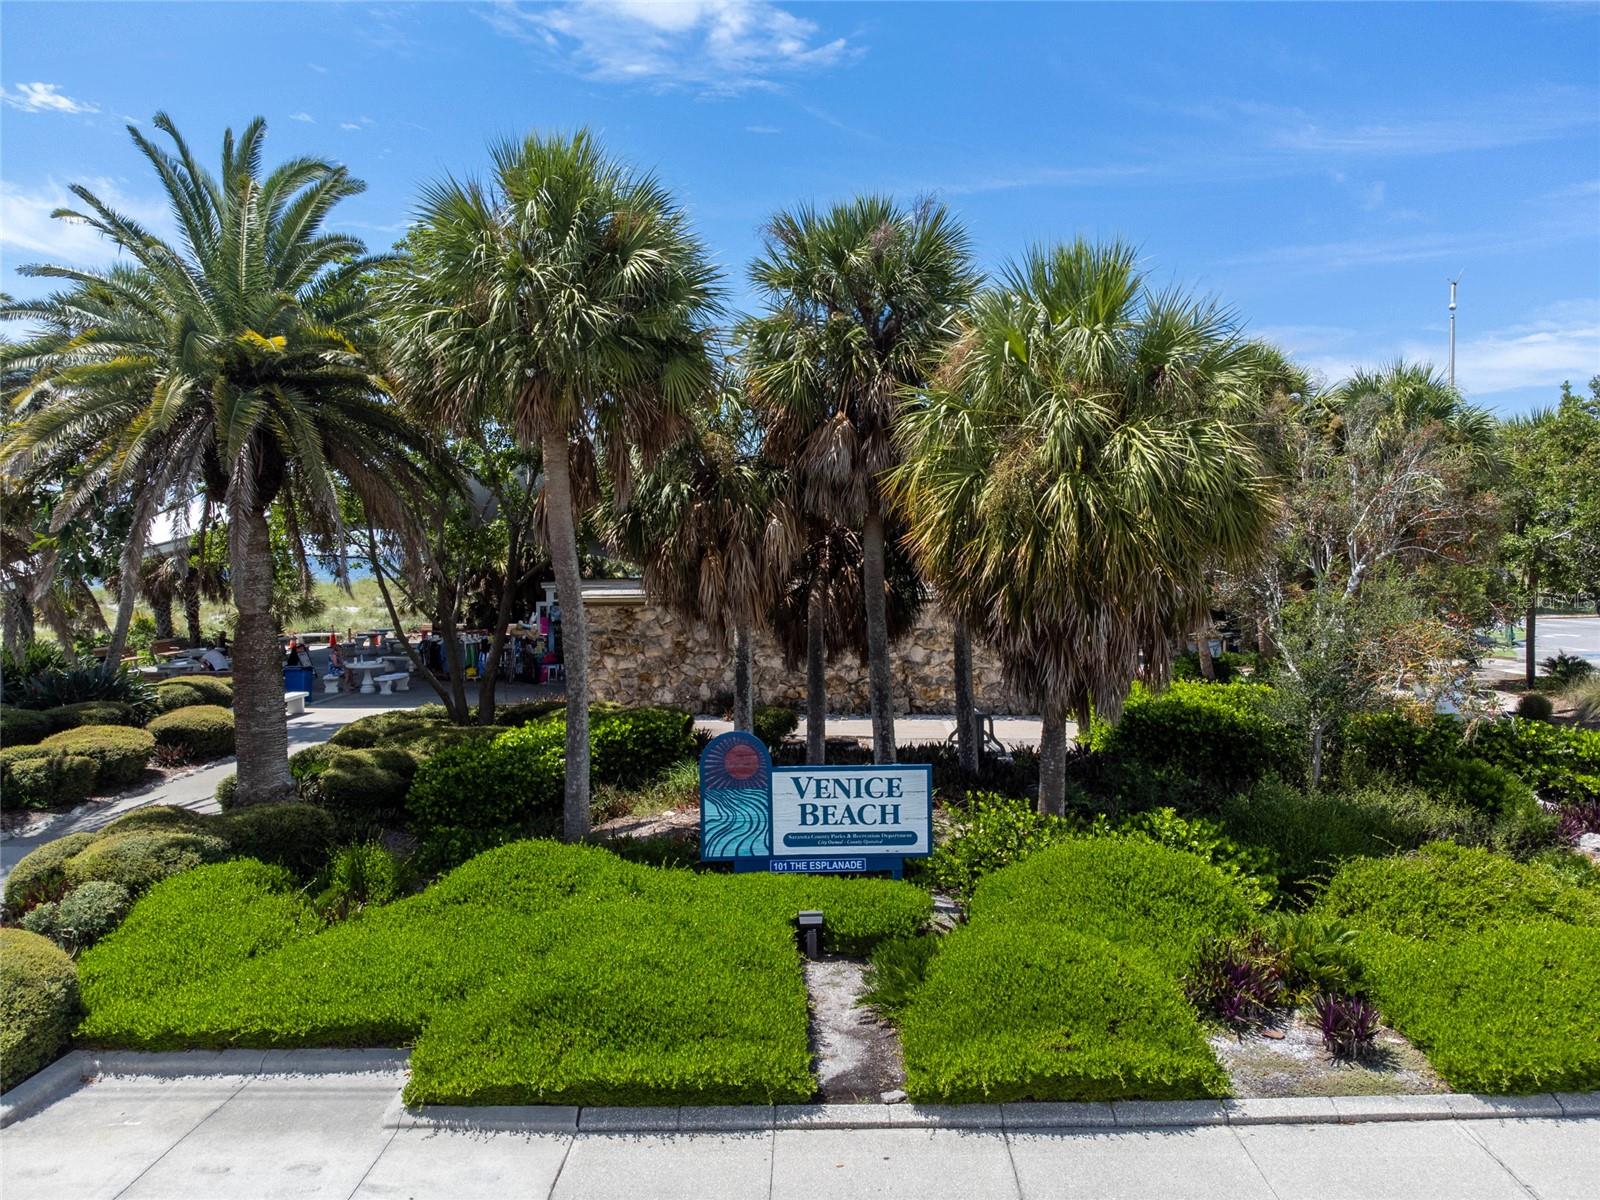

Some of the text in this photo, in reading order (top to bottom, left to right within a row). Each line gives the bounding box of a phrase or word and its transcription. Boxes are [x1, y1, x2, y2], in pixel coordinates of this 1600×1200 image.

[790, 777, 903, 799] VENICE
[798, 803, 901, 826] BEACH
[773, 860, 863, 870] 101 THE ESPLANADE
